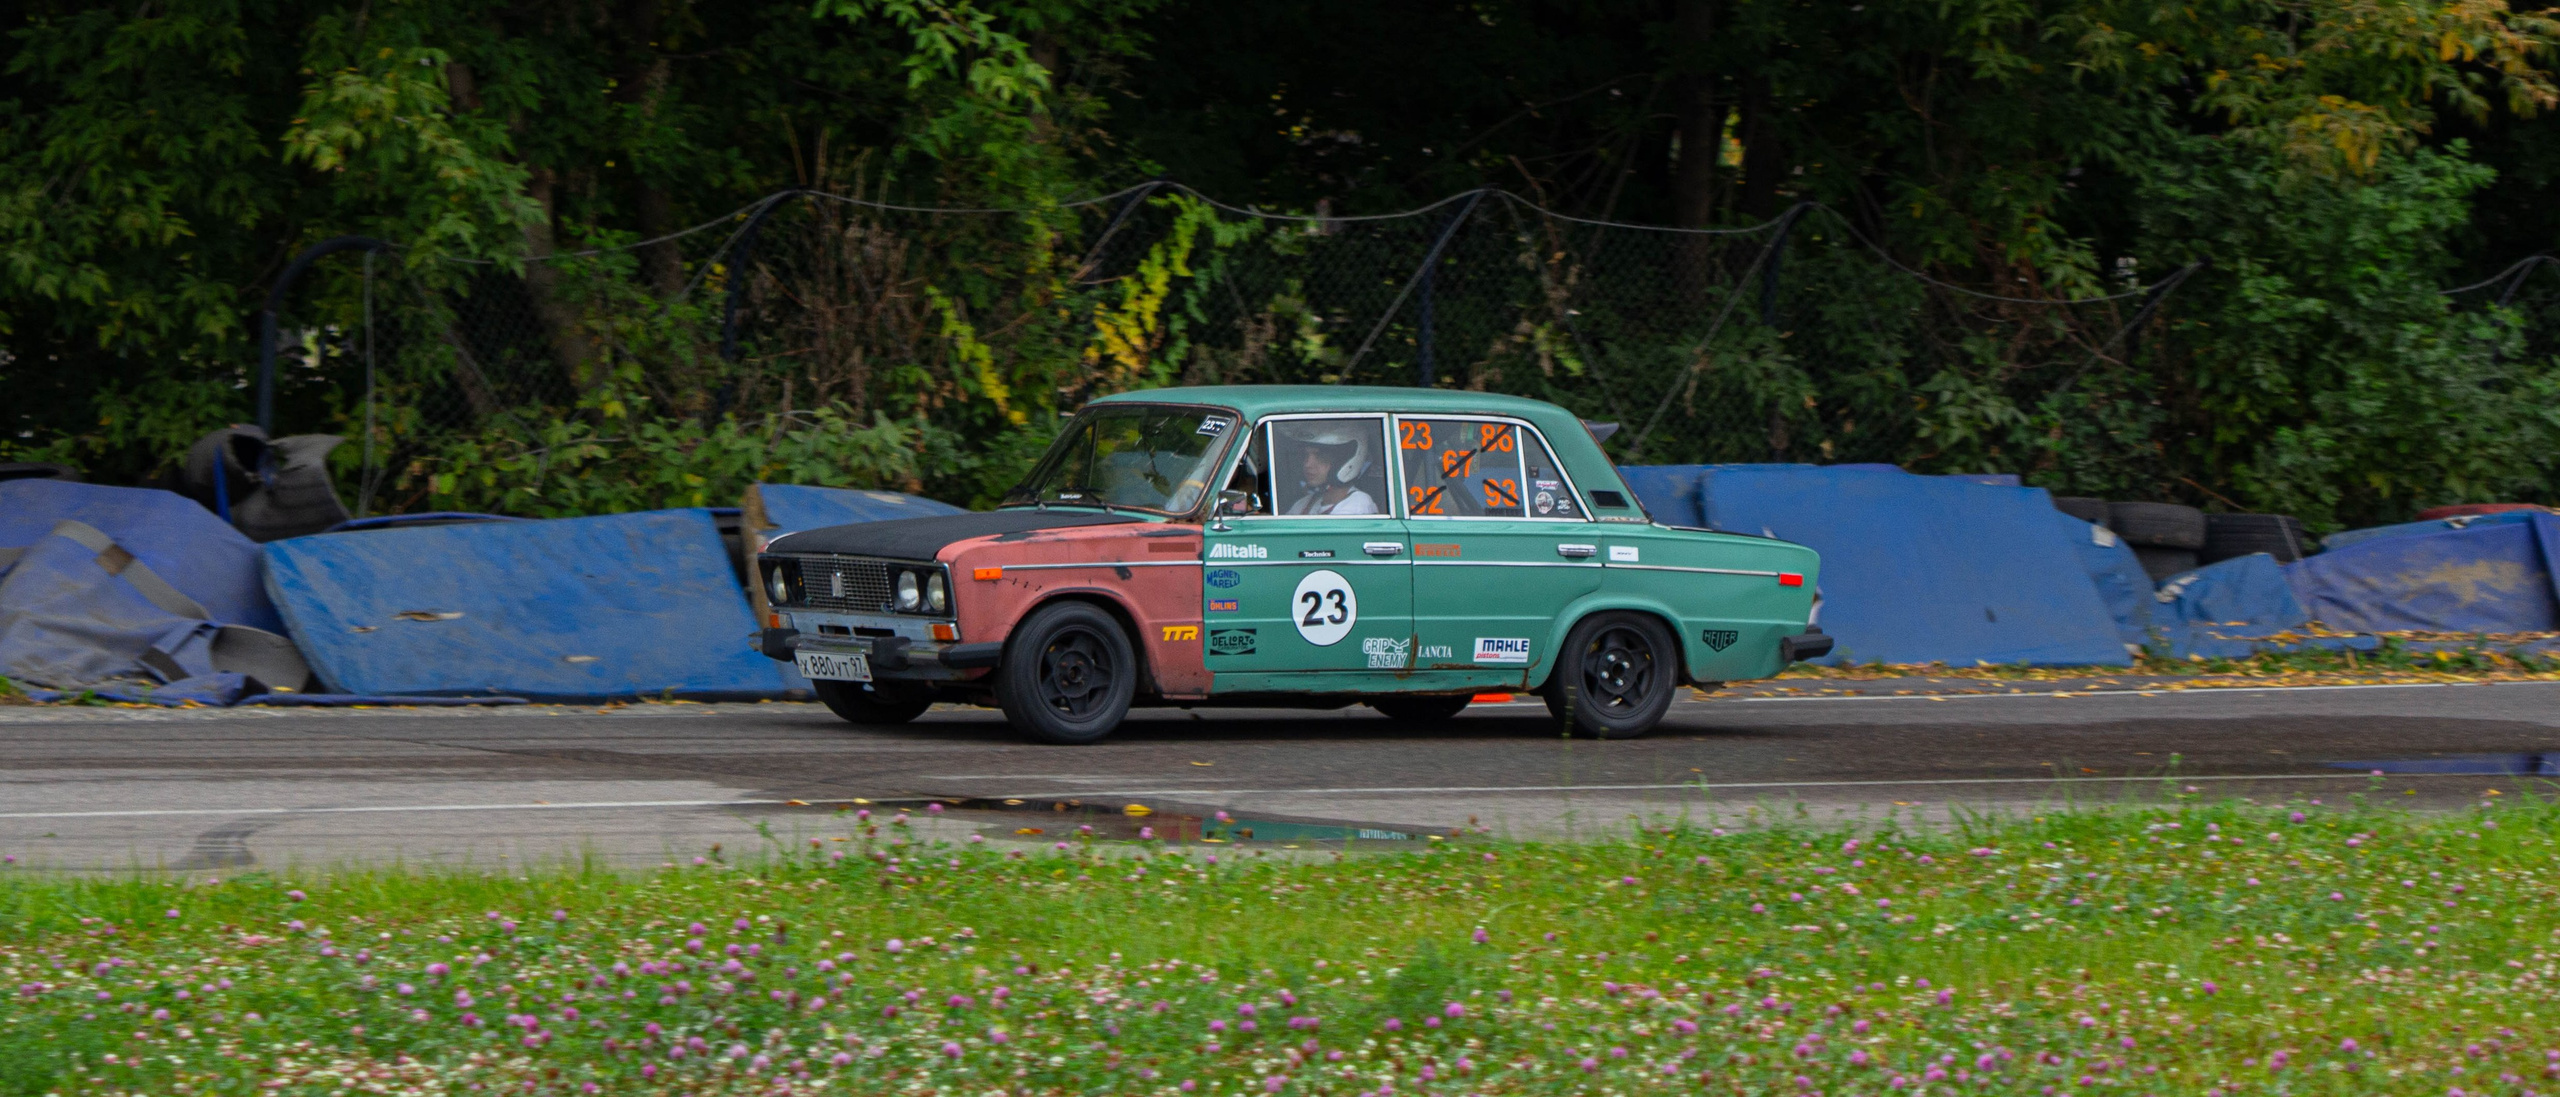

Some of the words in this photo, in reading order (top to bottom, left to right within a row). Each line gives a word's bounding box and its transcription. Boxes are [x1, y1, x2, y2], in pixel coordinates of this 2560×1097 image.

[1400, 421, 1433, 450] 23
[1481, 423, 1514, 452] 86
[1441, 450, 1474, 478] 67
[1409, 486, 1444, 515] 32
[1484, 478, 1518, 507] 93
[1209, 543, 1267, 558] Alitalia
[1301, 588, 1348, 627] 23
[1162, 625, 1198, 641] TTR
[1212, 635, 1255, 646] DELLORTO
[1704, 631, 1737, 650] HEUER
[1363, 638, 1390, 654] GRIP
[1418, 645, 1452, 658] LANCIA
[1483, 639, 1528, 652] MAHLE
[1368, 652, 1408, 668] ENEMY
